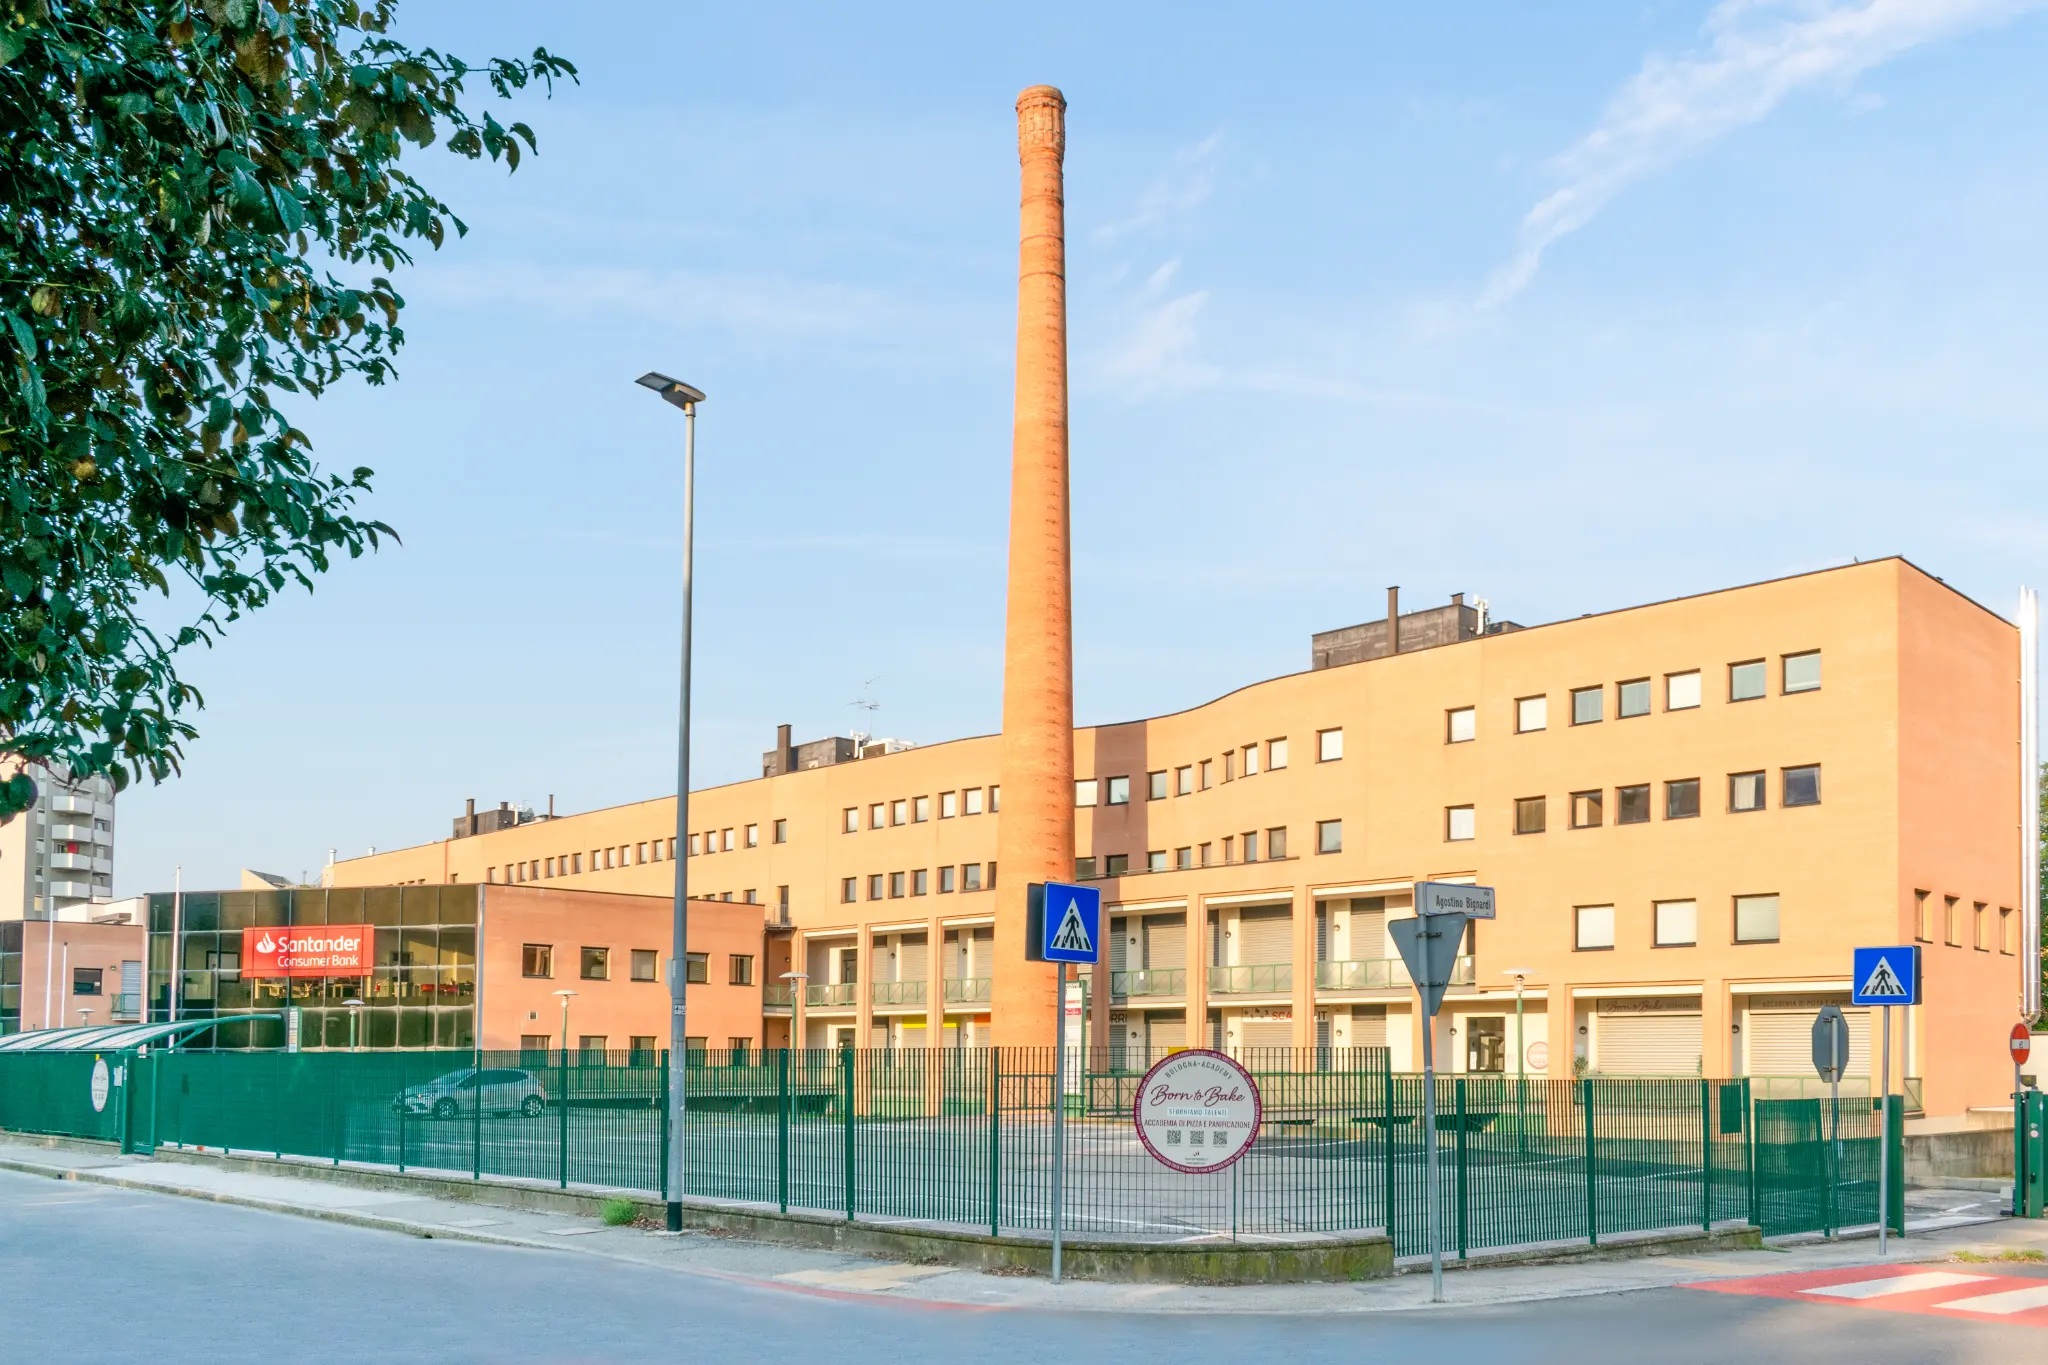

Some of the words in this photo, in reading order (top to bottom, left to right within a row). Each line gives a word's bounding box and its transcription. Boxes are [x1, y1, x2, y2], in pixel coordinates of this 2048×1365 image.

[1436, 895, 1464, 909] Agostino
[1466, 897, 1491, 911] Bignardi
[278, 936, 361, 953] Santander
[278, 956, 331, 967] Consumer
[332, 955, 359, 966] Bank
[1150, 1084, 1194, 1107] Born
[1194, 1089, 1203, 1102] to
[1204, 1086, 1246, 1107] Bake
[1168, 1108, 1203, 1116] SFORNIAMO
[1144, 1119, 1177, 1127] ACCADEMIA
[1178, 1119, 1185, 1127] DI
[1186, 1120, 1203, 1128] PIZZA
[1203, 1120, 1207, 1128] E
[1208, 1120, 1251, 1129] PANIFICAZIONE
